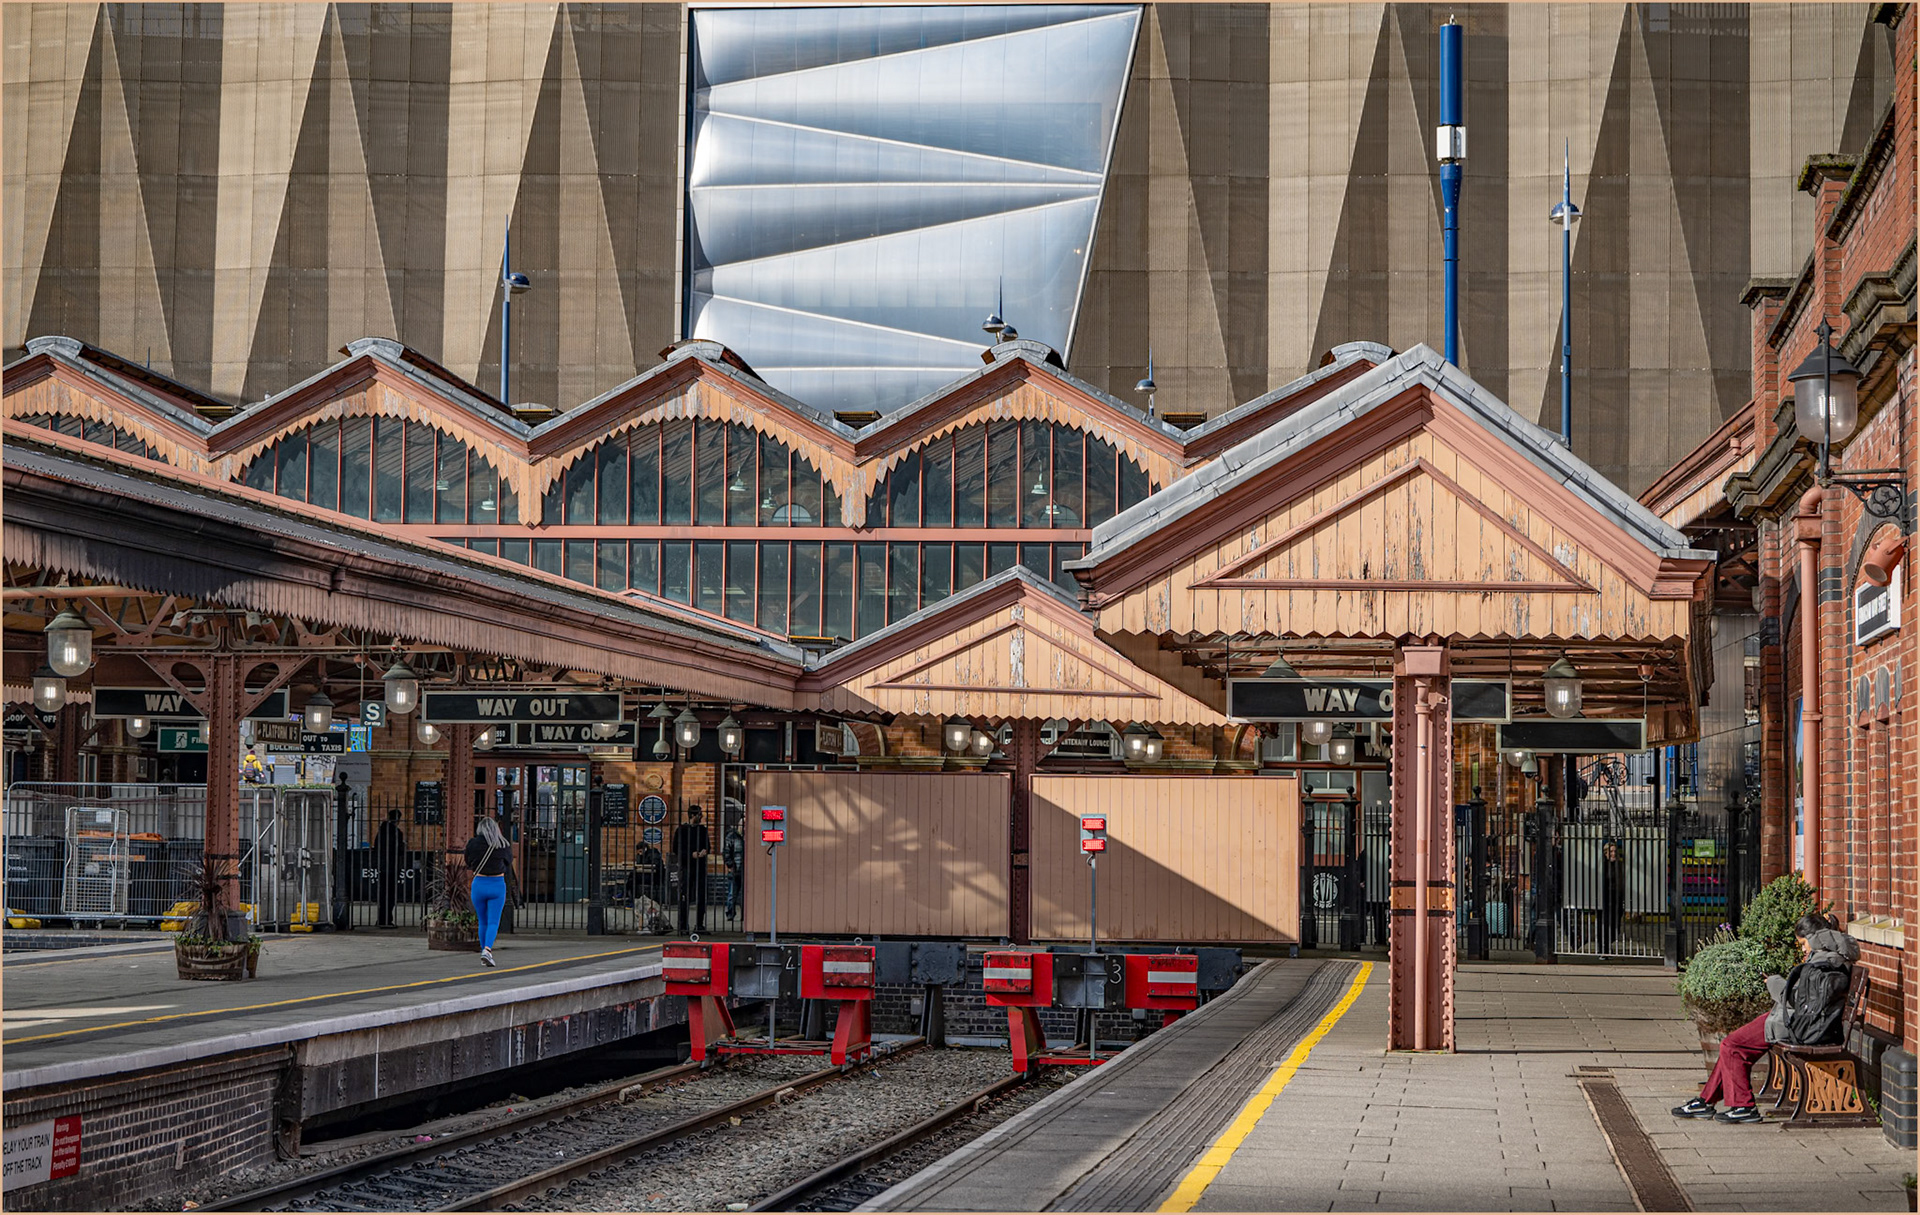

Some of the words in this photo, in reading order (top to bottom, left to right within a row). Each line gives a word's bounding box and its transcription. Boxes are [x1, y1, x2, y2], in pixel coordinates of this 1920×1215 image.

[144, 694, 184, 712] WAY
[476, 698, 517, 717] WAY
[529, 698, 570, 717] OUT
[1303, 688, 1360, 712] WAY
[42, 715, 57, 723] OFF
[366, 702, 380, 721] S
[262, 723, 288, 739] PLATFORM
[302, 735, 317, 743] OUT
[541, 726, 575, 740] WAY
[581, 726, 608, 741] OU
[321, 744, 342, 752] TAXIS
[785, 956, 796, 970] 4
[1110, 963, 1122, 984] 3
[3, 1139, 17, 1156] ELAY
[18, 1136, 33, 1152] YOUR
[34, 1133, 50, 1149] TRAIN
[3, 1163, 13, 1178] OFF
[14, 1159, 24, 1175] THE
[25, 1156, 42, 1172] TRACK
